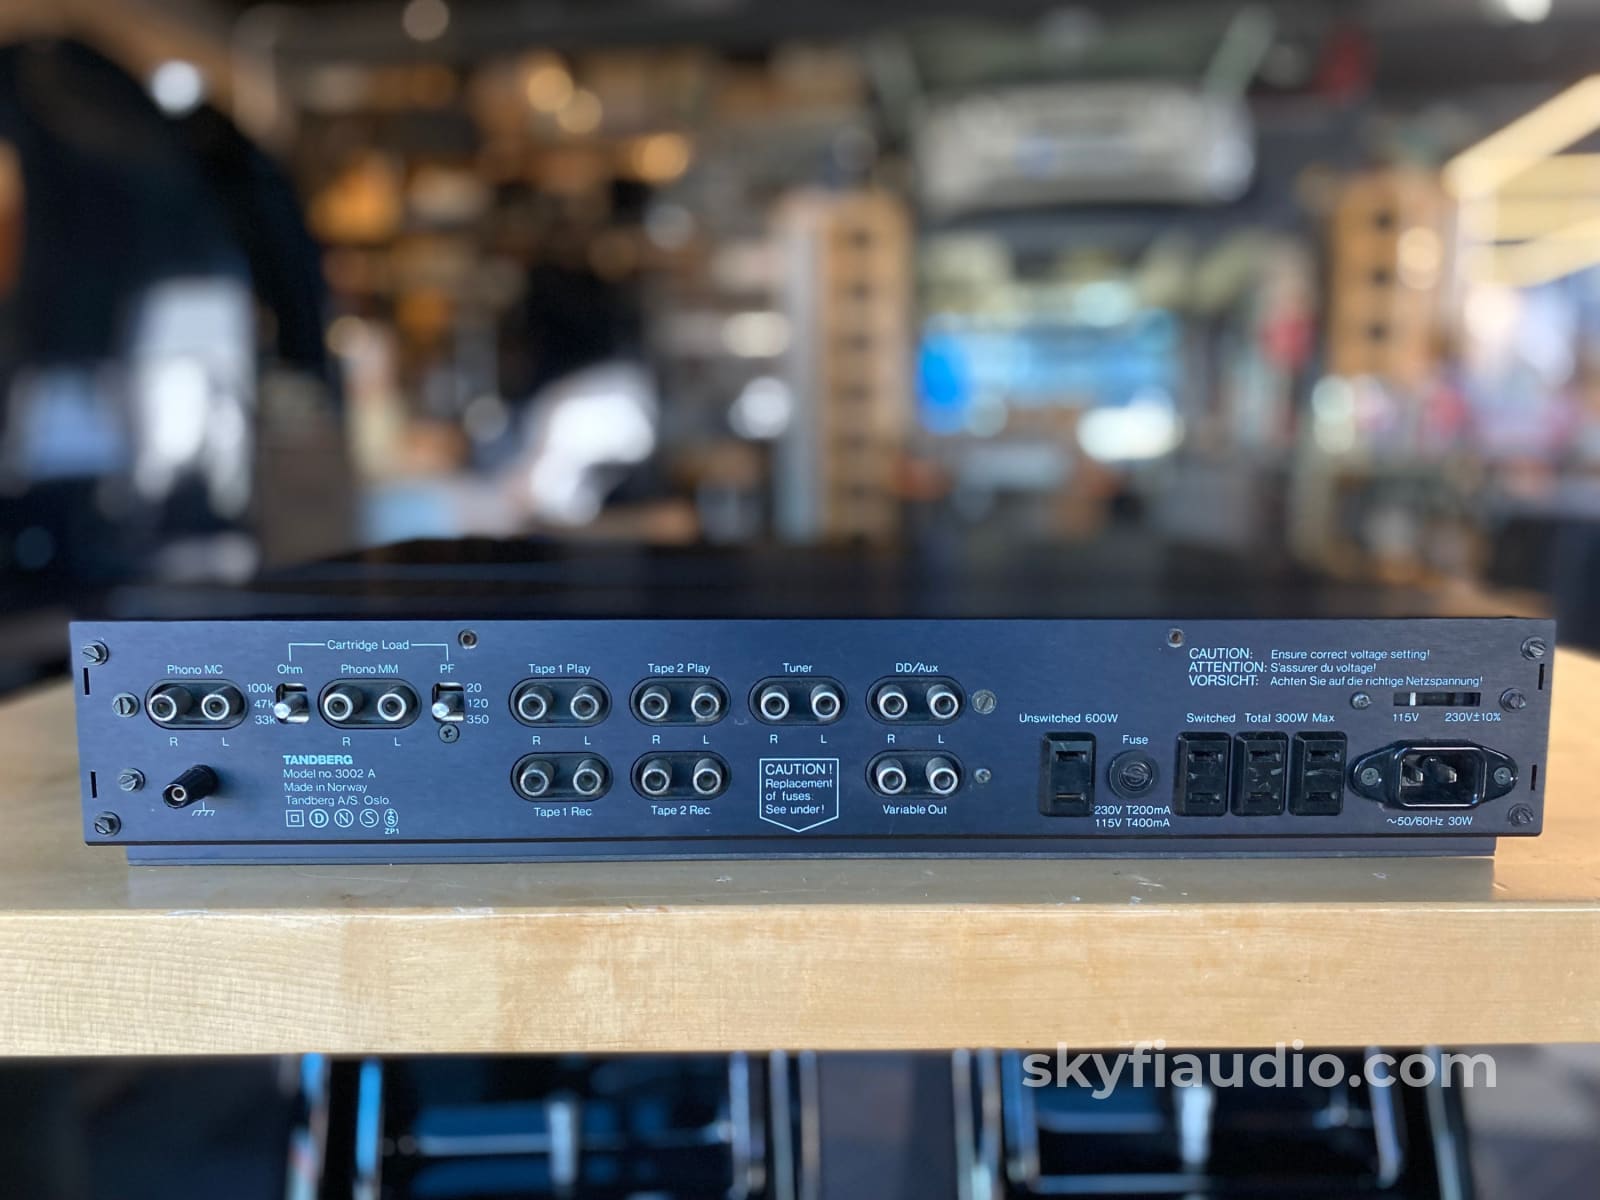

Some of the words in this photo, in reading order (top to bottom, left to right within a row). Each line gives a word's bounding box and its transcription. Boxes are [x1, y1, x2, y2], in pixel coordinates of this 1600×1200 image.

[327, 640, 378, 652] Cartridge
[382, 640, 409, 650] Load
[1189, 648, 1253, 659] CAUTION:
[1271, 650, 1307, 659] Ensure
[1310, 650, 1347, 659] correct
[1351, 650, 1388, 661] voltage
[1390, 649, 1430, 661] setting!
[167, 665, 201, 677] Phono
[204, 664, 223, 675] MC
[277, 664, 303, 674] Ohm
[341, 664, 376, 676] Phono
[378, 664, 398, 674] MM
[440, 664, 454, 673] PF
[528, 664, 556, 675] Tape
[567, 664, 590, 675] Play
[648, 663, 675, 675] Tape
[677, 663, 684, 673] 2
[687, 663, 710, 675] Play
[783, 663, 812, 673] Tuner
[896, 662, 938, 675] DD/Aux
[1189, 661, 1267, 673] ATTENTION:
[1270, 662, 1318, 673] S'assurer
[1320, 663, 1333, 672] du
[1336, 663, 1376, 674] voltage!
[1189, 674, 1259, 686] VORSICHT:
[1270, 676, 1306, 686] Achten
[1309, 676, 1326, 686] Sie
[1329, 676, 1345, 685] auf
[1347, 676, 1363, 685] die
[1365, 676, 1404, 688] richtige
[1406, 676, 1482, 687] Netzspannung!
[247, 683, 274, 695] 100k
[466, 683, 482, 693] 20
[254, 699, 275, 709] 47k
[468, 698, 488, 708] 120
[255, 715, 276, 724] 33k
[467, 714, 489, 724] 350
[1019, 713, 1081, 723] Unswitched
[1085, 713, 1118, 723] 600W
[1187, 713, 1235, 723] Switched
[1245, 713, 1271, 723] Total
[1275, 713, 1308, 723] 300W
[1312, 713, 1335, 723] Max
[1393, 713, 1419, 722] 115V
[1445, 712, 1501, 722] 230V±10%
[170, 735, 178, 746] R
[222, 737, 230, 746] L
[343, 735, 351, 746] R
[394, 736, 401, 746] L
[533, 736, 541, 745] R
[585, 736, 591, 745] L
[652, 735, 660, 744] R
[704, 735, 709, 744] L
[770, 734, 778, 744] R
[821, 734, 827, 743] L
[888, 734, 895, 743] R
[938, 734, 944, 743] L
[1123, 735, 1148, 744] Fuse
[283, 755, 353, 765] TANDBERG
[283, 768, 316, 780] Model
[335, 769, 365, 779] 3002
[368, 769, 376, 778] A
[284, 782, 313, 792] Made
[316, 782, 325, 793] in
[327, 782, 367, 793] Norway
[766, 778, 832, 790] Replacement
[285, 794, 334, 808] Tandberg
[765, 791, 776, 801] of
[533, 807, 560, 818] Tape
[651, 805, 677, 816] Tape
[680, 805, 687, 815] 2
[766, 804, 786, 814] See
[791, 804, 824, 814] under!
[883, 804, 926, 815] Variable
[928, 804, 947, 814] Out
[1095, 805, 1122, 815] 230V
[1126, 805, 1171, 815] T200mA
[1096, 818, 1122, 827] 115V
[1126, 818, 1170, 828] T400mA
[1448, 816, 1472, 826] 30W
[384, 826, 399, 834] ZP1
